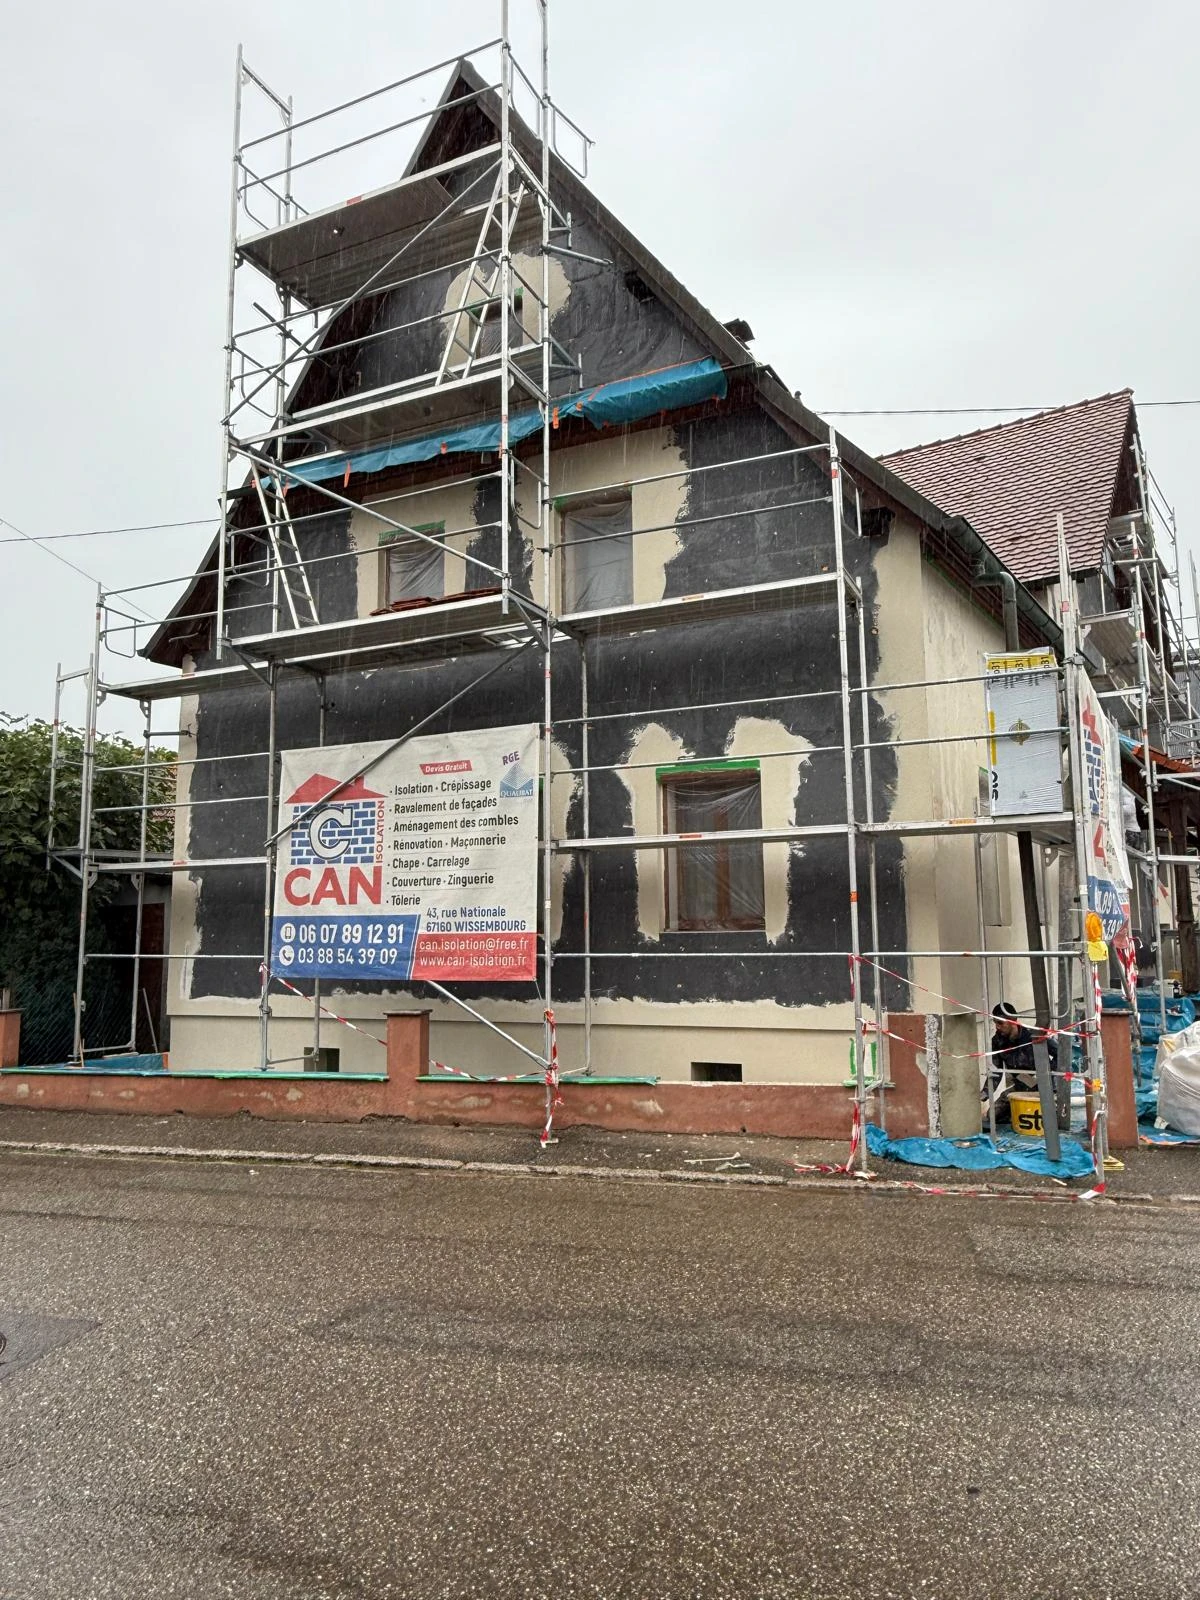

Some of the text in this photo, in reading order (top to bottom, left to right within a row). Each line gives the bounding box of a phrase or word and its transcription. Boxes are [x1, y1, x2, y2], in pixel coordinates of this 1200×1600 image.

[502, 751, 520, 766] RGE
[425, 762, 467, 773] Devis Gratuit
[394, 779, 492, 795] Isolation Crépissage
[500, 788, 533, 798] QUALIBAT
[394, 797, 498, 814] Ravalement de façades
[393, 814, 519, 833] Aménagement des combles
[309, 806, 354, 861] C
[376, 800, 385, 864] ISOLATION
[393, 833, 506, 850] Rénovation Maçonnerie
[392, 856, 470, 870] Chape Carrelage
[284, 866, 383, 906] CAN
[391, 873, 494, 887] Couverture Zinguerie
[391, 894, 421, 906] Tôlerie
[426, 906, 506, 920] 43, rue Nationale
[299, 923, 404, 944] 06 07 89 12 91
[426, 920, 527, 932] 67160 WISSEMBOURG
[420, 937, 529, 951] can.isolation@free.fr
[298, 947, 398, 964] 03 88 54 39 09
[420, 954, 527, 967] www.can-isolation.fr
[1018, 1109, 1044, 1131] st
